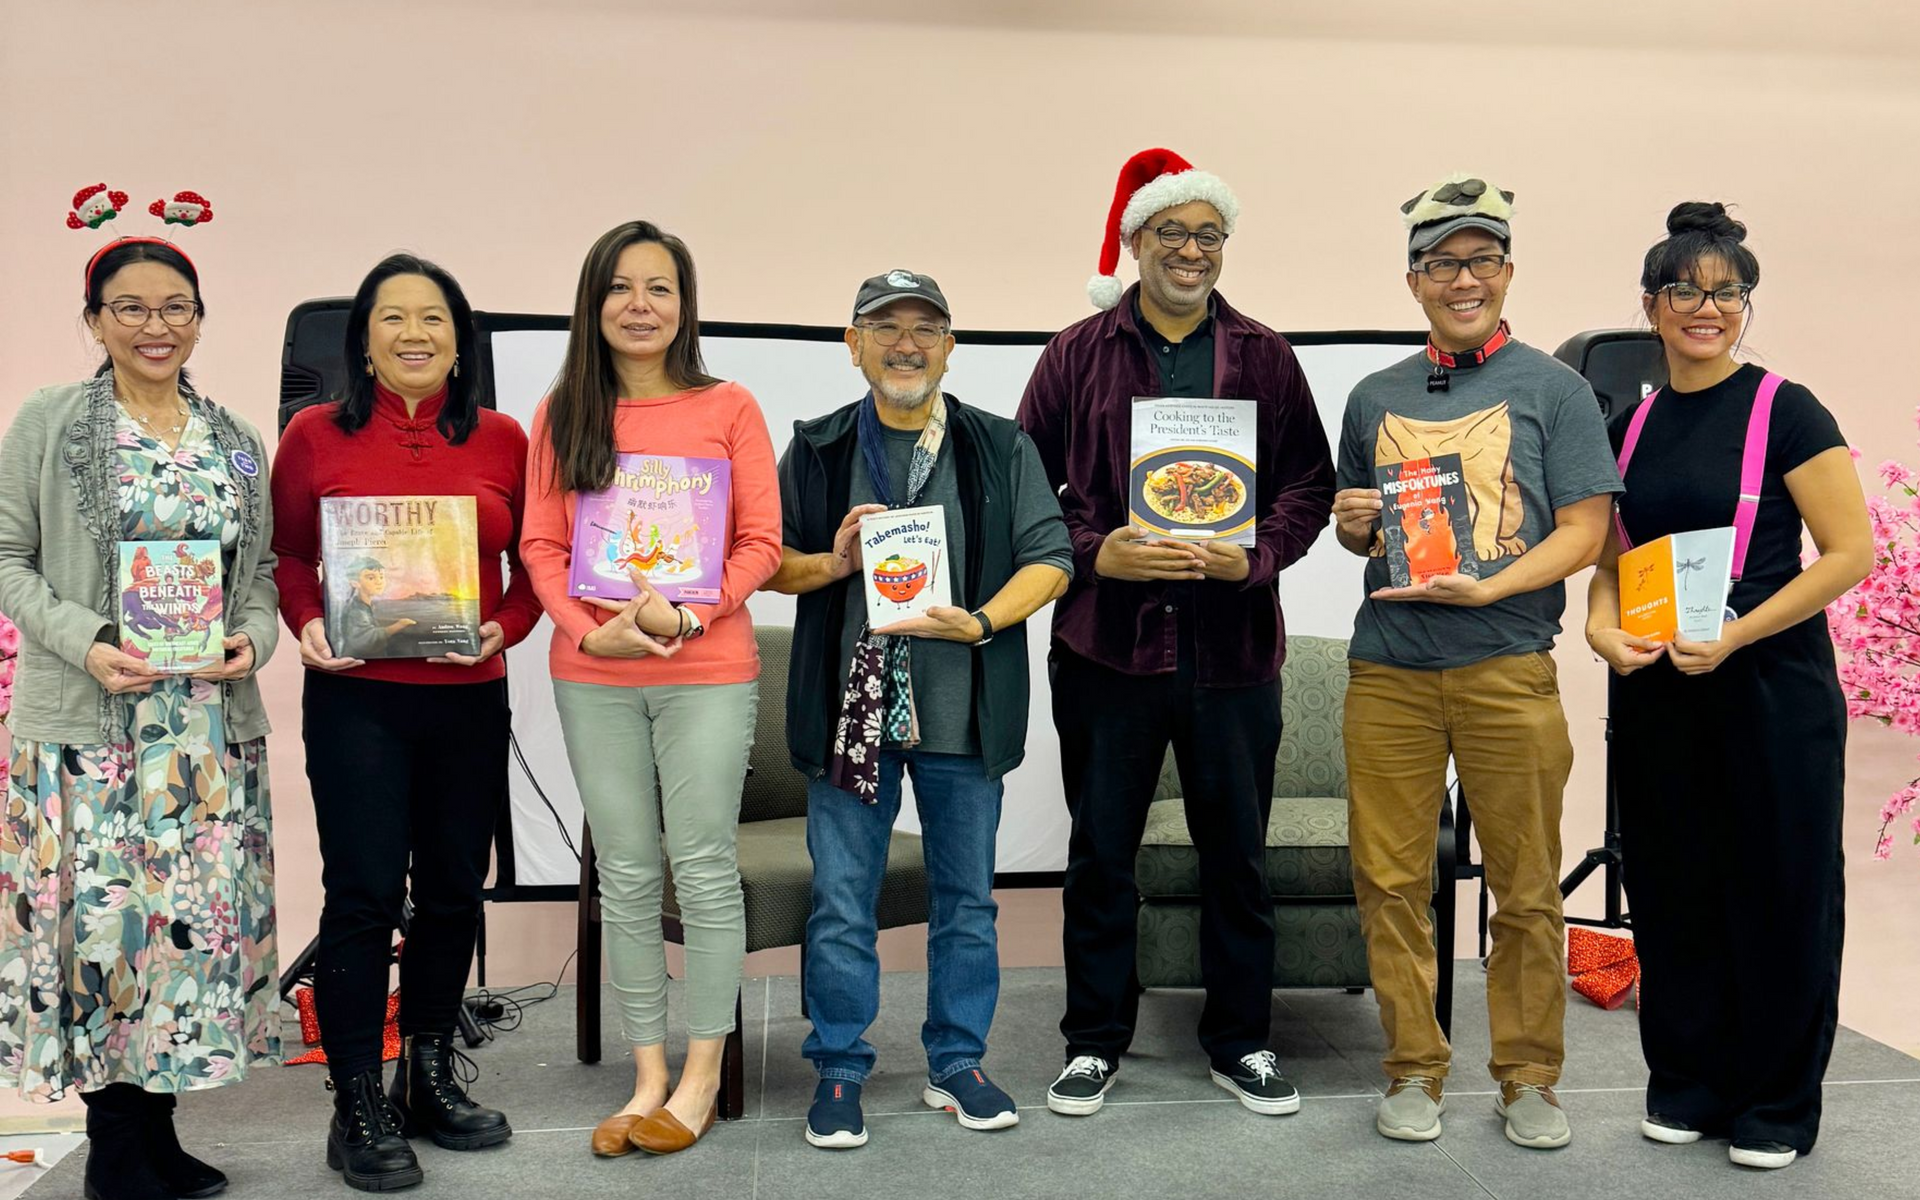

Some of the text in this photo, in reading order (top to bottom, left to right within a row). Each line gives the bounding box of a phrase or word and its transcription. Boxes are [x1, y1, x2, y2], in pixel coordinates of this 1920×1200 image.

[1153, 410, 1236, 424] Cooking to the
[1150, 423, 1240, 436] President's Taste
[641, 459, 671, 477] Silly
[1420, 465, 1441, 475] Many
[608, 466, 713, 499] hrimphony
[1383, 471, 1460, 495] MISFORTUNES
[1393, 499, 1423, 511] Eugenia
[330, 500, 437, 526] WORTHY
[864, 519, 931, 549] Tabemasho!
[145, 564, 195, 578] BEASTS
[139, 584, 203, 599] BENEATH
[155, 602, 202, 615] WINDS
[1626, 596, 1669, 617] THOUGHTS
